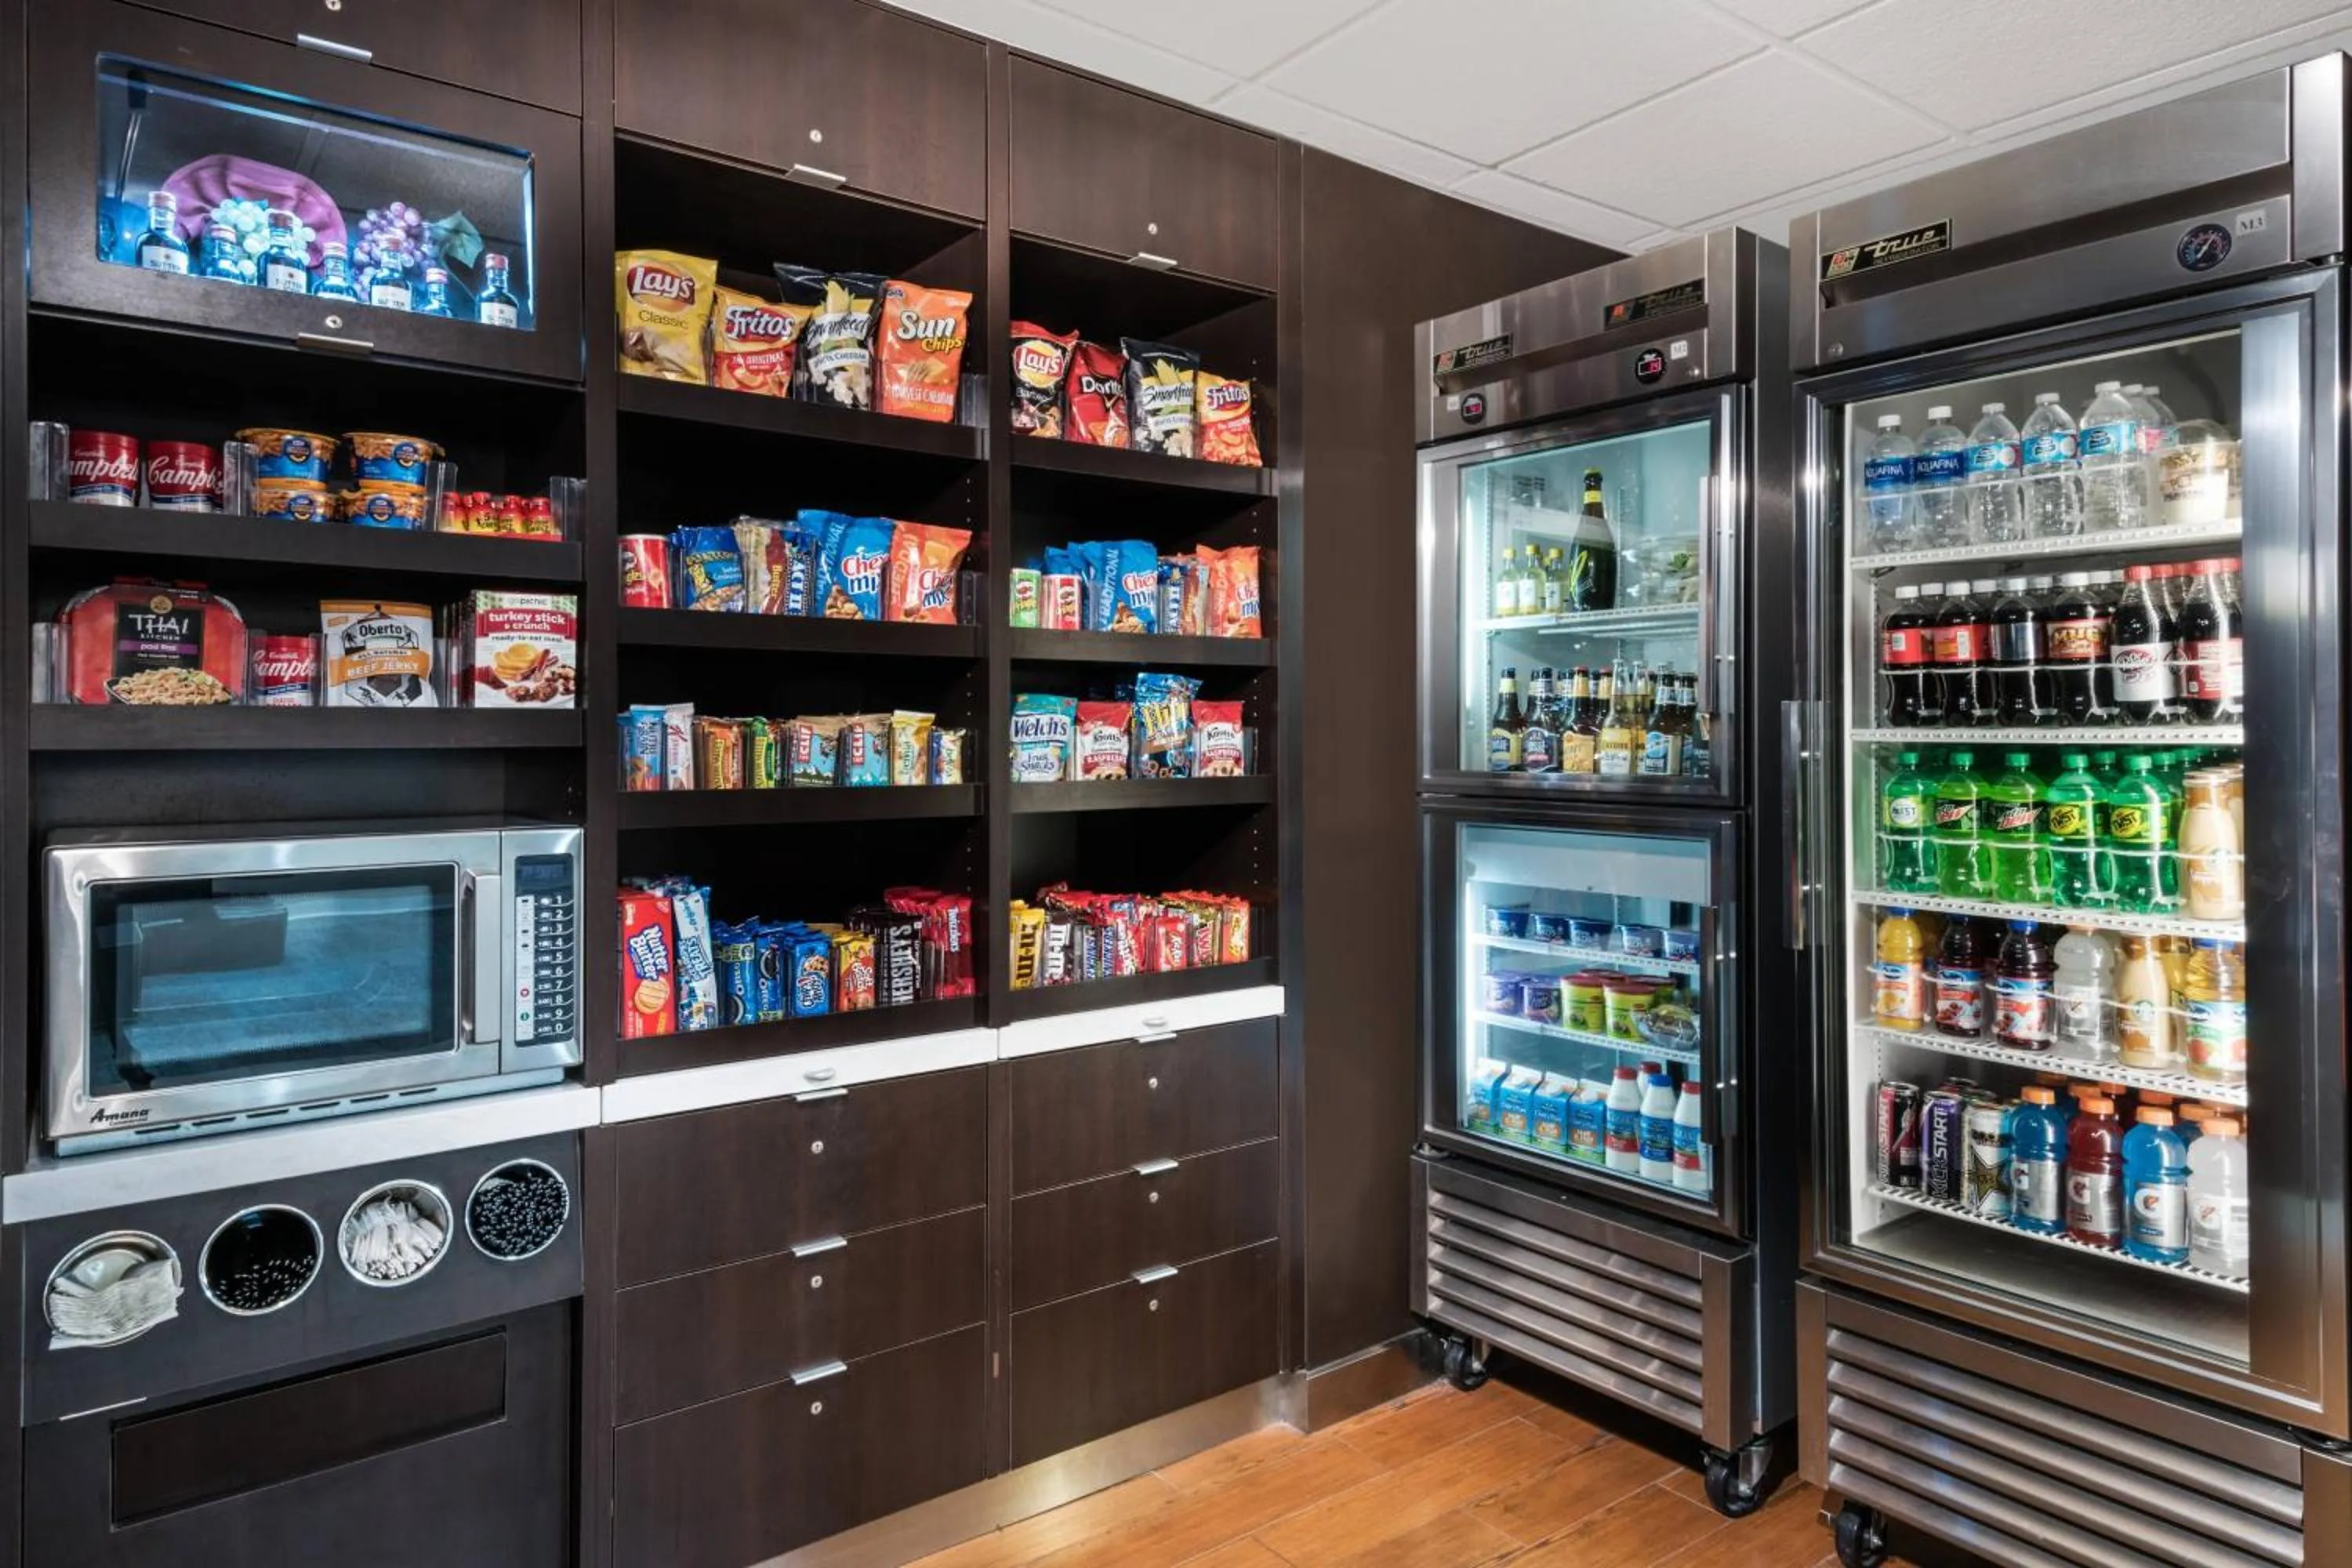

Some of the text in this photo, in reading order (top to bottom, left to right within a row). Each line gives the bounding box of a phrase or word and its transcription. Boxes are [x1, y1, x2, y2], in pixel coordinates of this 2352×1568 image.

[633, 267, 695, 299] Lay's
[639, 310, 689, 329] Classic
[726, 307, 795, 340] Fritos
[897, 310, 956, 339] Sun
[922, 336, 963, 354] Chips
[1019, 347, 1060, 374] Lay's
[1081, 376, 1124, 396] Dorit
[849, 576, 879, 594] mi
[129, 614, 189, 635] THAI
[488, 610, 565, 625] turkey stick
[358, 623, 403, 637] Oberto
[511, 621, 551, 632] crunch
[347, 660, 419, 677] BEEF JERKY
[1014, 717, 1068, 738] Welch's
[556, 895, 563, 905] 1
[556, 909, 563, 919] 2
[556, 924, 563, 932] 3
[556, 937, 563, 946] 4
[643, 924, 669, 973] Nutter
[556, 952, 563, 960] 5
[630, 936, 659, 980] Butter
[556, 966, 563, 975] 6
[890, 924, 914, 1007] HERSHEY'S
[556, 980, 563, 990] 7
[556, 994, 563, 1004] 8
[556, 1008, 563, 1018] 9
[556, 1023, 563, 1033] 0
[90, 1107, 151, 1123] Amana
[1932, 1105, 1949, 1199] KICKSTART
